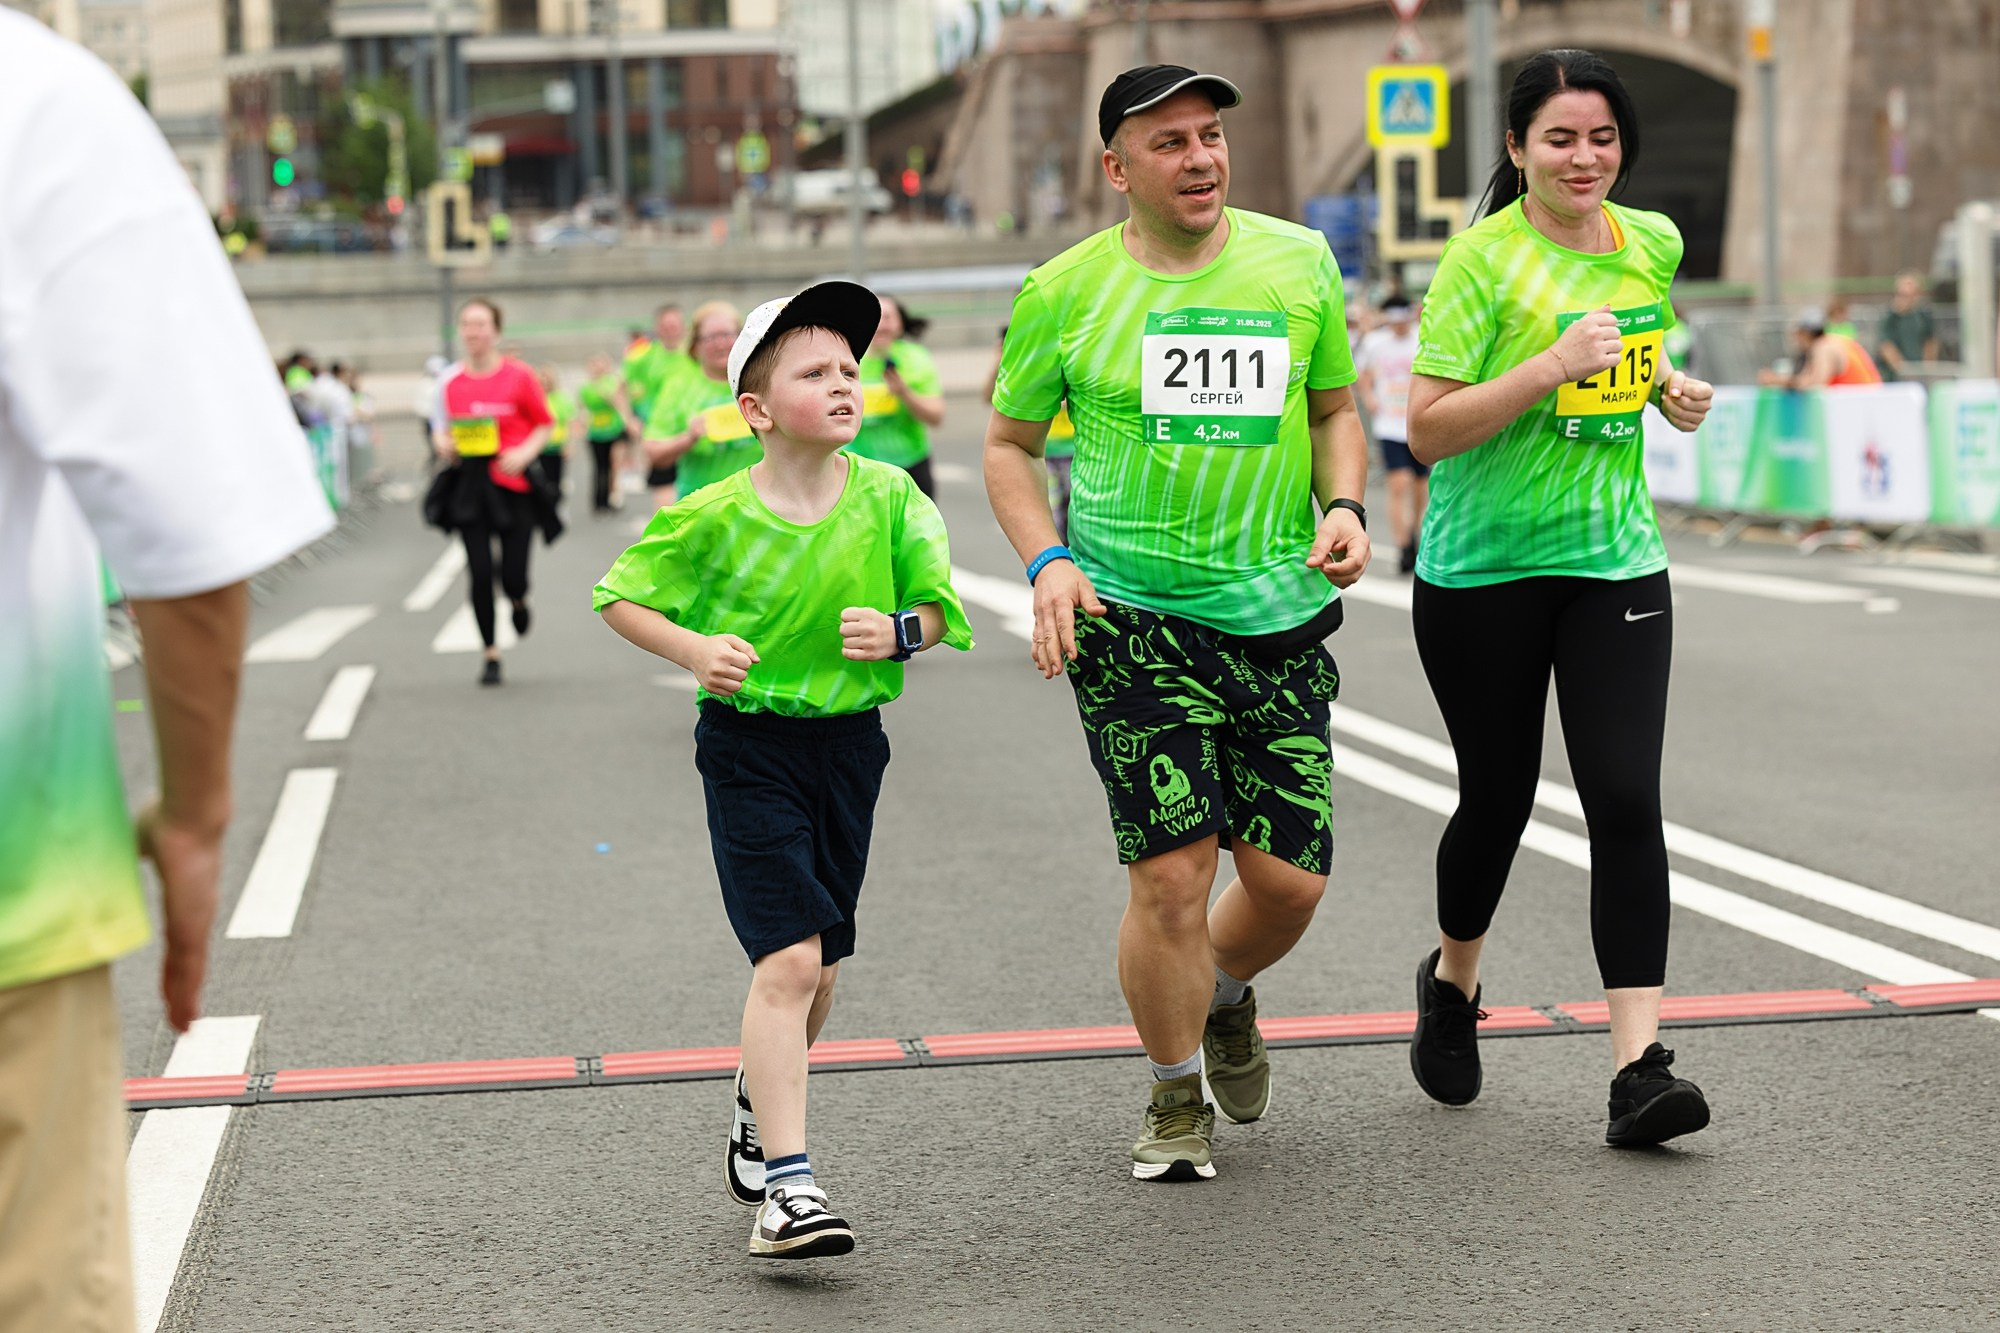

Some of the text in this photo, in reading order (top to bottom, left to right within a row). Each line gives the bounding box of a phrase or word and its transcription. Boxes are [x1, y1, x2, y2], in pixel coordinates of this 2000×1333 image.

[1235, 318, 1272, 328] 31.05.2025
[1163, 348, 1264, 389] 2111
[1190, 391, 1243, 405] СЕРГЕЙ
[1601, 390, 1638, 404] МАРИЯ
[1155, 418, 1171, 441] E
[1564, 418, 1582, 438] E
[1217, 651, 1245, 684] Never
[1249, 683, 1261, 694] or
[1199, 738, 1213, 771] Now
[1149, 794, 1196, 825] Mona
[1163, 796, 1211, 836] Who?
